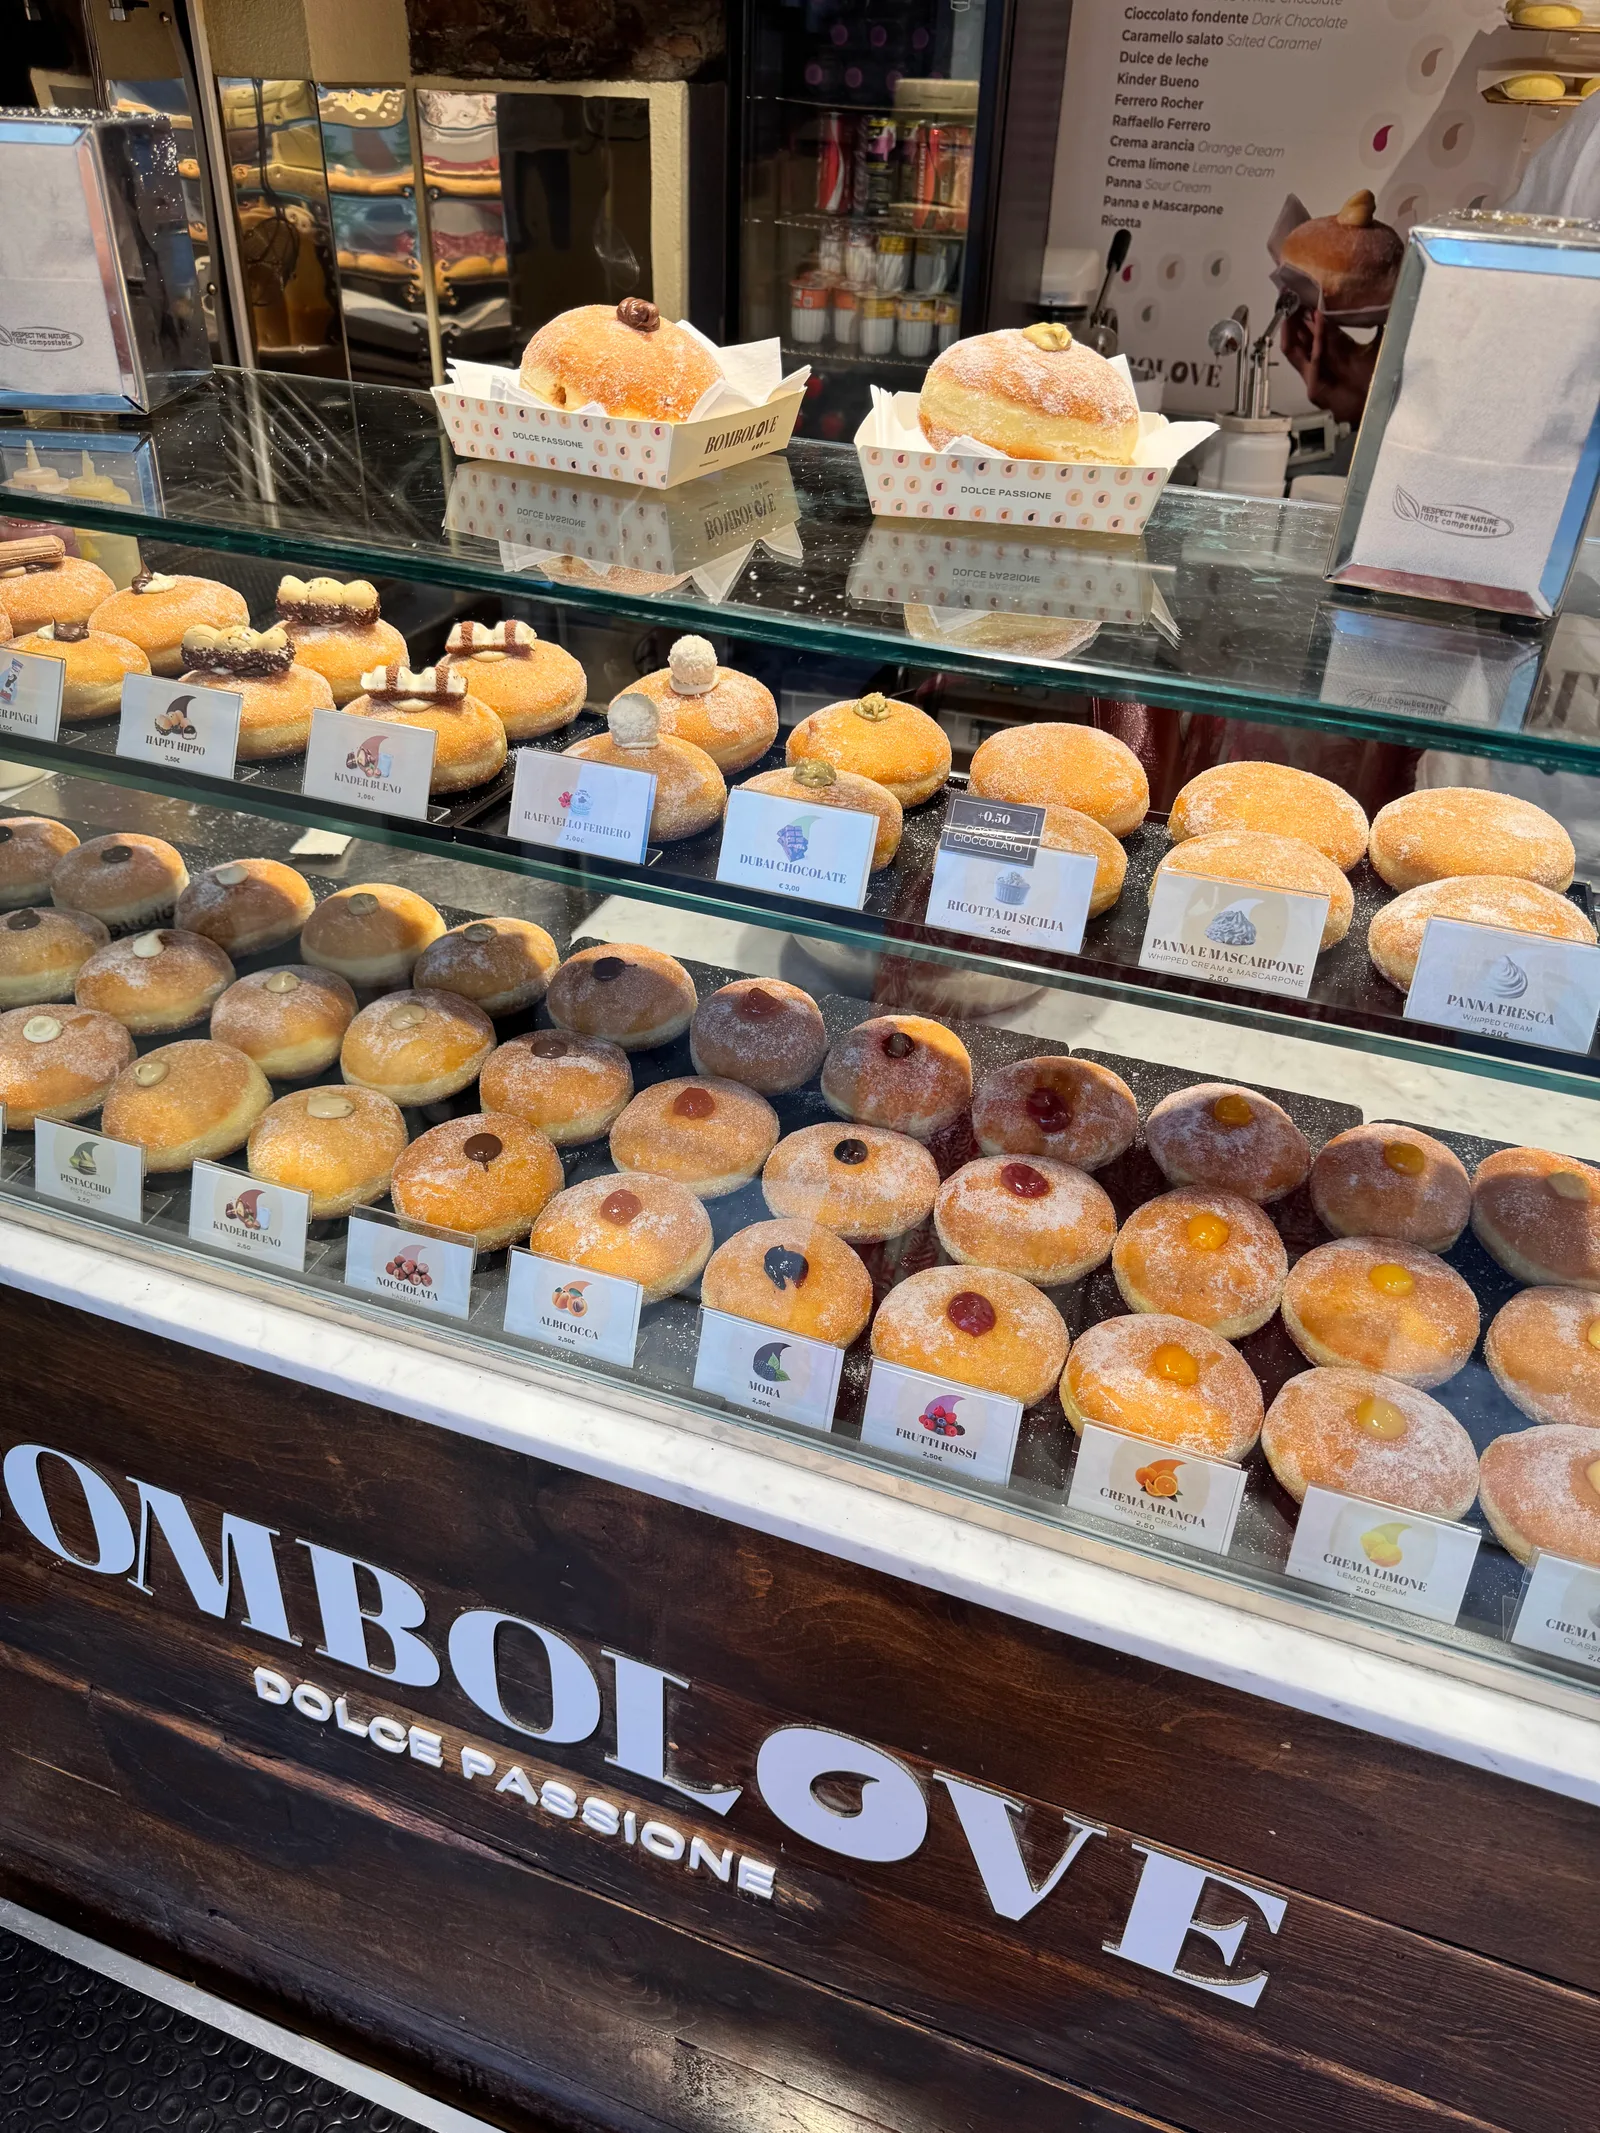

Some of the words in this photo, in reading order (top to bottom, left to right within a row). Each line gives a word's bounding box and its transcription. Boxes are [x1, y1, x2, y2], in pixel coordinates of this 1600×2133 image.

[1124, 7, 1189, 23] Cioccolato
[1192, 11, 1248, 24] fondente
[1252, 13, 1281, 26] Dark
[1284, 14, 1348, 29] Chocolate
[1122, 30, 1183, 44] Caramello
[1186, 33, 1223, 45] salato
[1227, 34, 1264, 48] Salted
[1268, 36, 1321, 51] Caramel
[1120, 51, 1154, 64] Dulce
[1157, 53, 1172, 65] de
[1175, 54, 1208, 67] leche
[1117, 73, 1156, 85] Kinder
[1160, 76, 1199, 88] Bueno
[1115, 94, 1157, 107] Ferrero
[1161, 97, 1203, 110] Rocher
[1112, 115, 1164, 129] Raffaello
[1167, 118, 1210, 131] Ferrero
[1110, 136, 1148, 149] Crema
[1152, 138, 1194, 152] arancia
[1198, 140, 1242, 156] Orange
[1245, 144, 1284, 157] Cream
[1108, 156, 1146, 169] Crema
[1149, 158, 1189, 172] limone
[1192, 162, 1232, 175] Lemon
[1235, 164, 1275, 178] Cream
[1105, 176, 1142, 189] Panna
[1173, 181, 1211, 193] Cream
[1103, 196, 1139, 208] Panna
[1143, 200, 1149, 209] e
[1152, 198, 1223, 216] Mascarpone
[1101, 215, 1141, 228] Ricotta
[11, 331, 35, 339] RESPECT
[513, 431, 539, 442] DOLCE
[542, 436, 583, 449] PASSIONE
[704, 416, 779, 454] BOMBOLOVE
[961, 486, 996, 495] DOLCE
[999, 489, 1052, 499] PASSIONE
[1418, 513, 1439, 523] 100%
[1441, 519, 1497, 534] compostable
[1421, 505, 1453, 518] RESPECT
[1455, 511, 1469, 521] THE
[1470, 514, 1500, 527] NATURE
[9, 711, 37, 725] PINGUÌ
[146, 735, 177, 749] HAPPY
[178, 742, 205, 756] HIPPO
[334, 772, 369, 788] KINDER
[370, 780, 402, 794] BUENO
[524, 811, 581, 830] RAFFAELLO
[583, 822, 631, 839] FERRERO
[978, 811, 1010, 825] +0,50
[954, 833, 1023, 852] CIOCCOLATO
[740, 854, 775, 869] DUBAI
[777, 861, 847, 884] CHOCOLATE
[785, 884, 800, 892] 3,00
[947, 899, 1001, 919] RICOTTA
[1004, 910, 1017, 922] DI
[1018, 914, 1064, 932] SICILIA
[990, 927, 1011, 936] 2,50€
[1152, 938, 1195, 956] PANNA
[1198, 947, 1206, 958] E
[1210, 949, 1305, 976] MASCARPONE
[1148, 952, 1189, 965] WHIPPED
[1191, 960, 1225, 972] CREAM
[1236, 968, 1304, 988] MASCARPONE
[1446, 994, 1494, 1015] PANNA
[1497, 1005, 1556, 1026] FRESCA
[1462, 1014, 1500, 1026] WHIPPED
[1503, 1022, 1533, 1033] CREAM
[60, 1173, 111, 1195] PISTACCHIO
[213, 1221, 248, 1237] KINDER
[250, 1232, 281, 1247] BUENO
[376, 1276, 438, 1301] NOCCIOLATA
[539, 1316, 598, 1340] ALBICOCCA
[558, 1336, 575, 1345] 2,50€
[748, 1380, 780, 1398] MORA
[752, 1397, 771, 1408] 2,50€
[896, 1427, 939, 1448] FRUTTI
[941, 1440, 977, 1460] ROSSI
[923, 1451, 942, 1462] 2,50€
[1100, 1487, 1144, 1508] CREMA
[1147, 1502, 1208, 1528] ARANCIA
[1114, 1504, 1152, 1521] ORANGE
[1154, 1515, 1187, 1531] CREAM
[1323, 1553, 1371, 1576] CREMA
[1374, 1569, 1428, 1592] LIMONE
[1336, 1570, 1371, 1587] LEMON
[1372, 1580, 1407, 1597] CREAM
[1546, 1618, 1596, 1641] CREMA
[253, 1666, 444, 1769] DOLCE
[459, 1746, 776, 1901] PASSIONE
